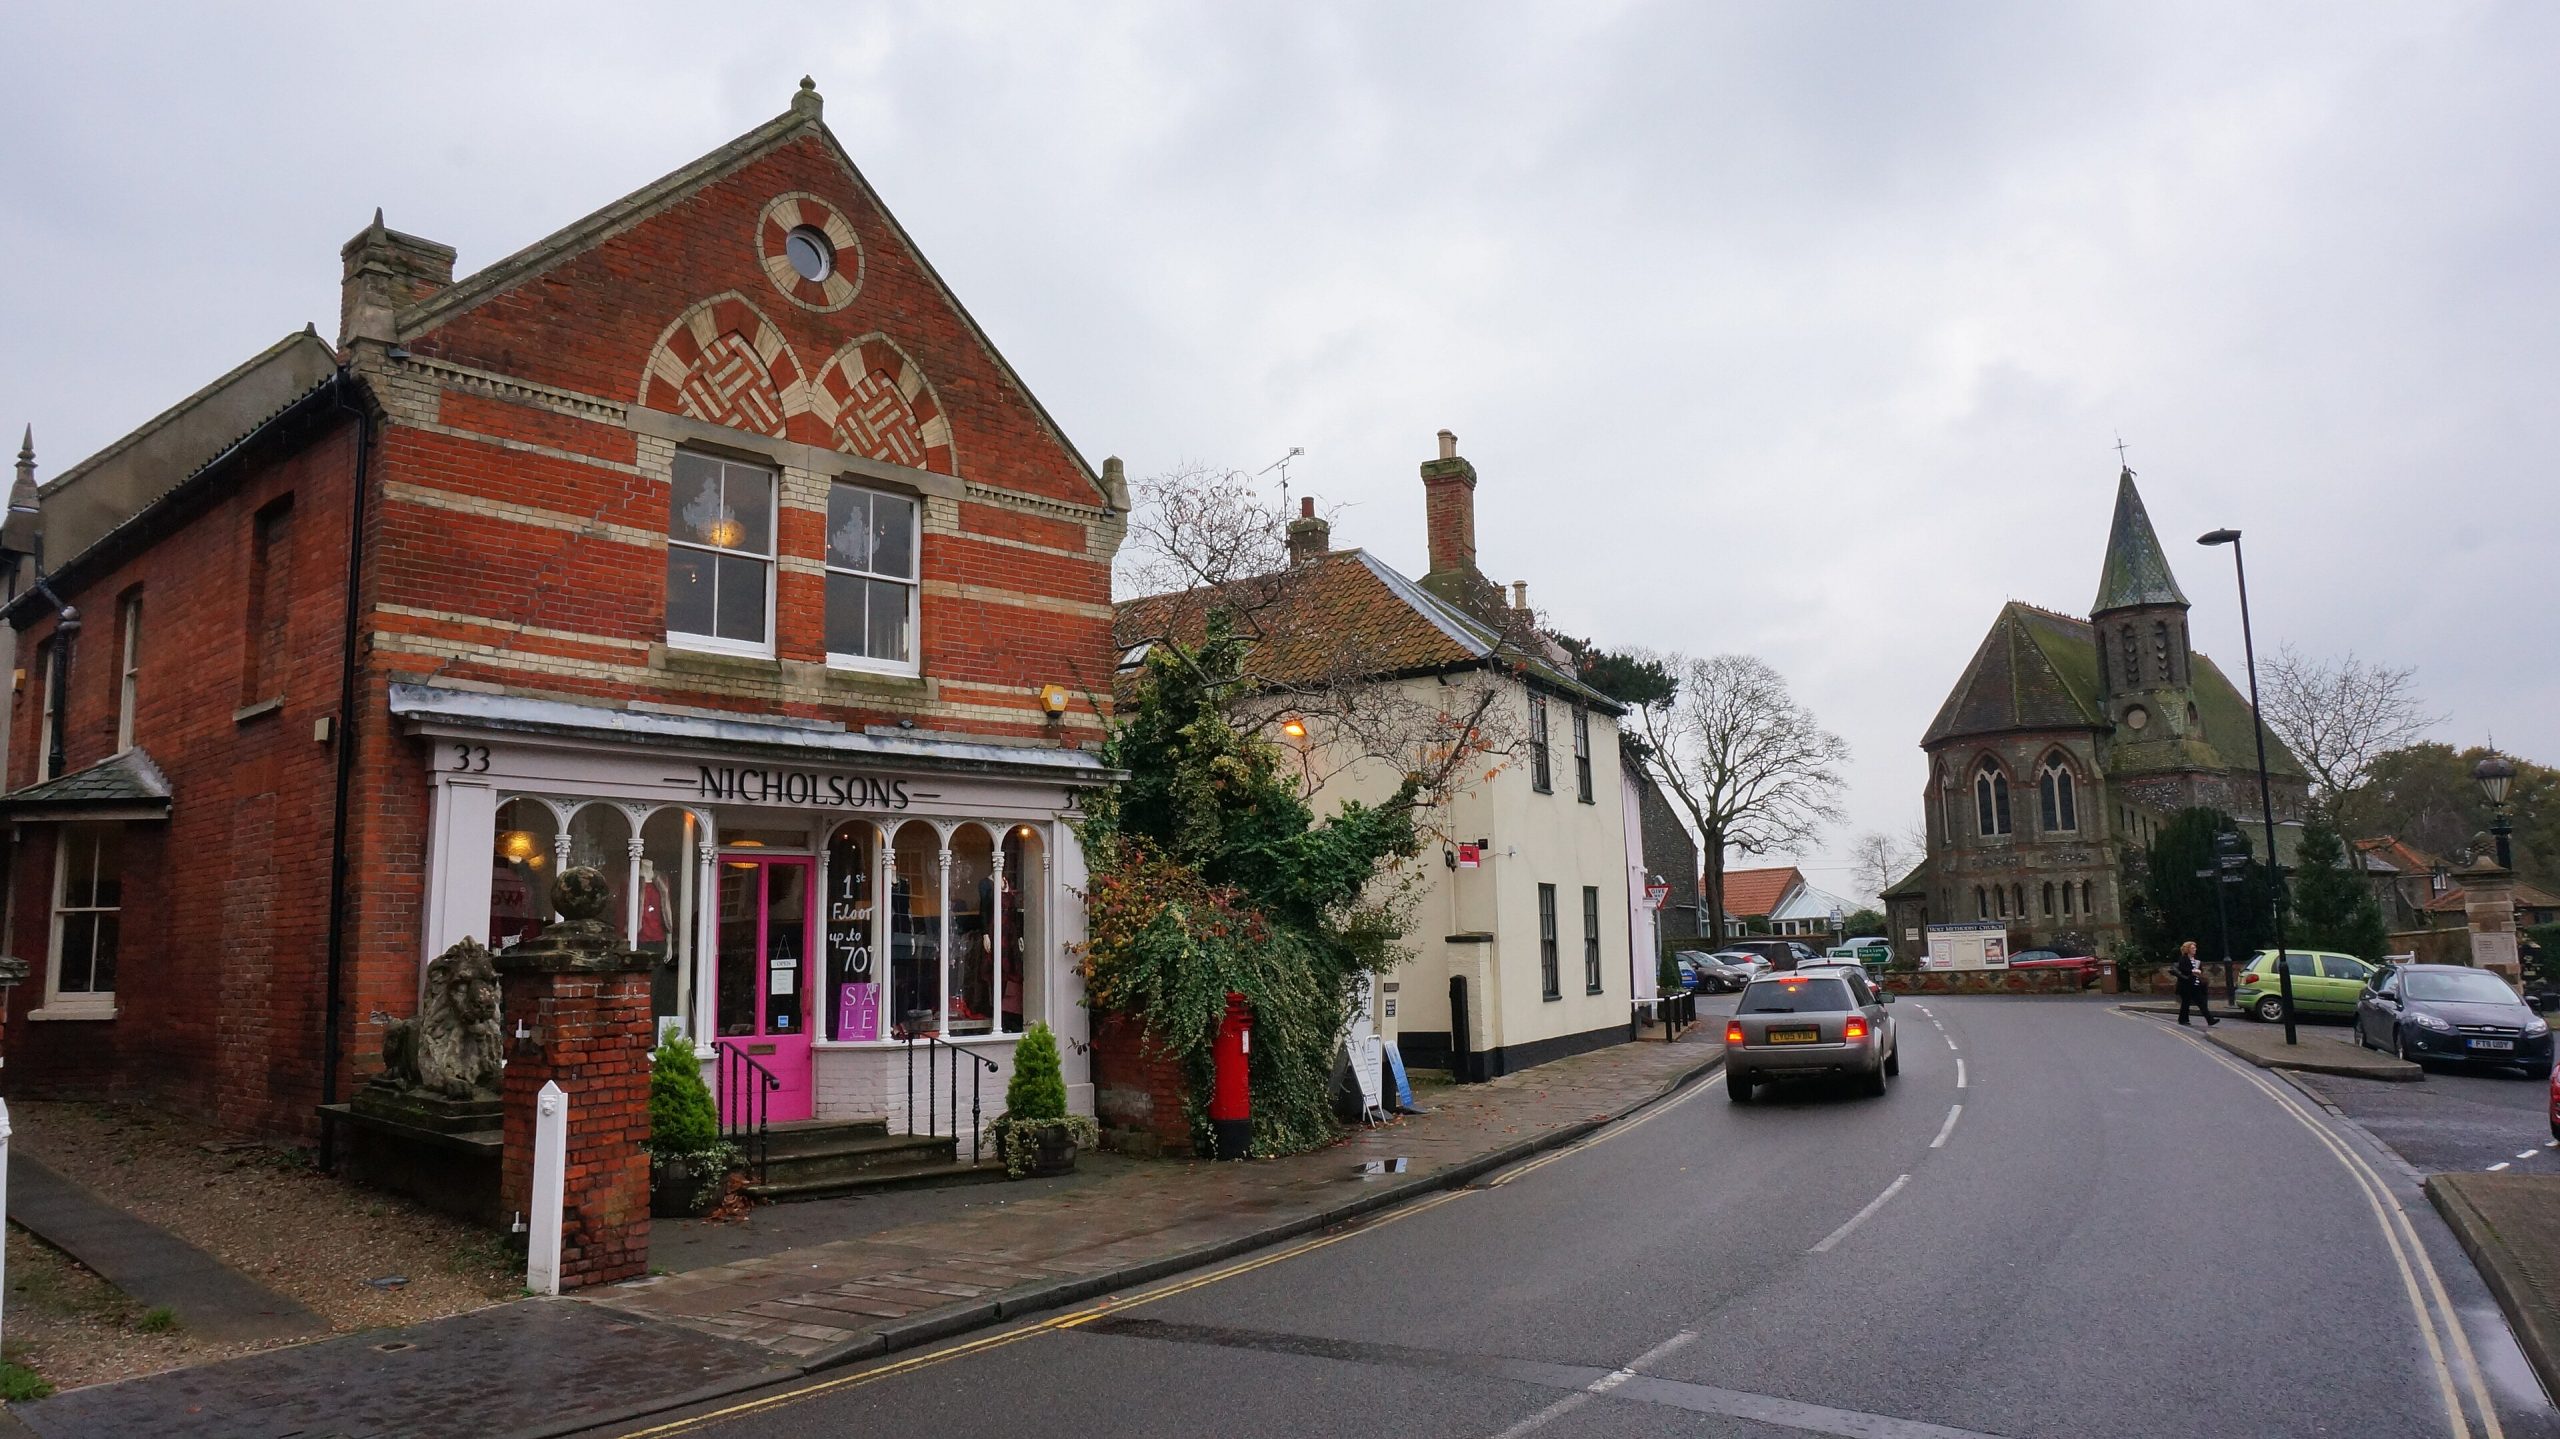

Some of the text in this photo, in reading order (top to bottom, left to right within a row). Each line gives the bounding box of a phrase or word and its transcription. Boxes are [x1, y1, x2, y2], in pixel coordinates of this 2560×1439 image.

[453, 744, 490, 772] 33
[699, 766, 909, 809] NICHOLSONS
[832, 902, 875, 921] Floor
[829, 927, 861, 949] up to
